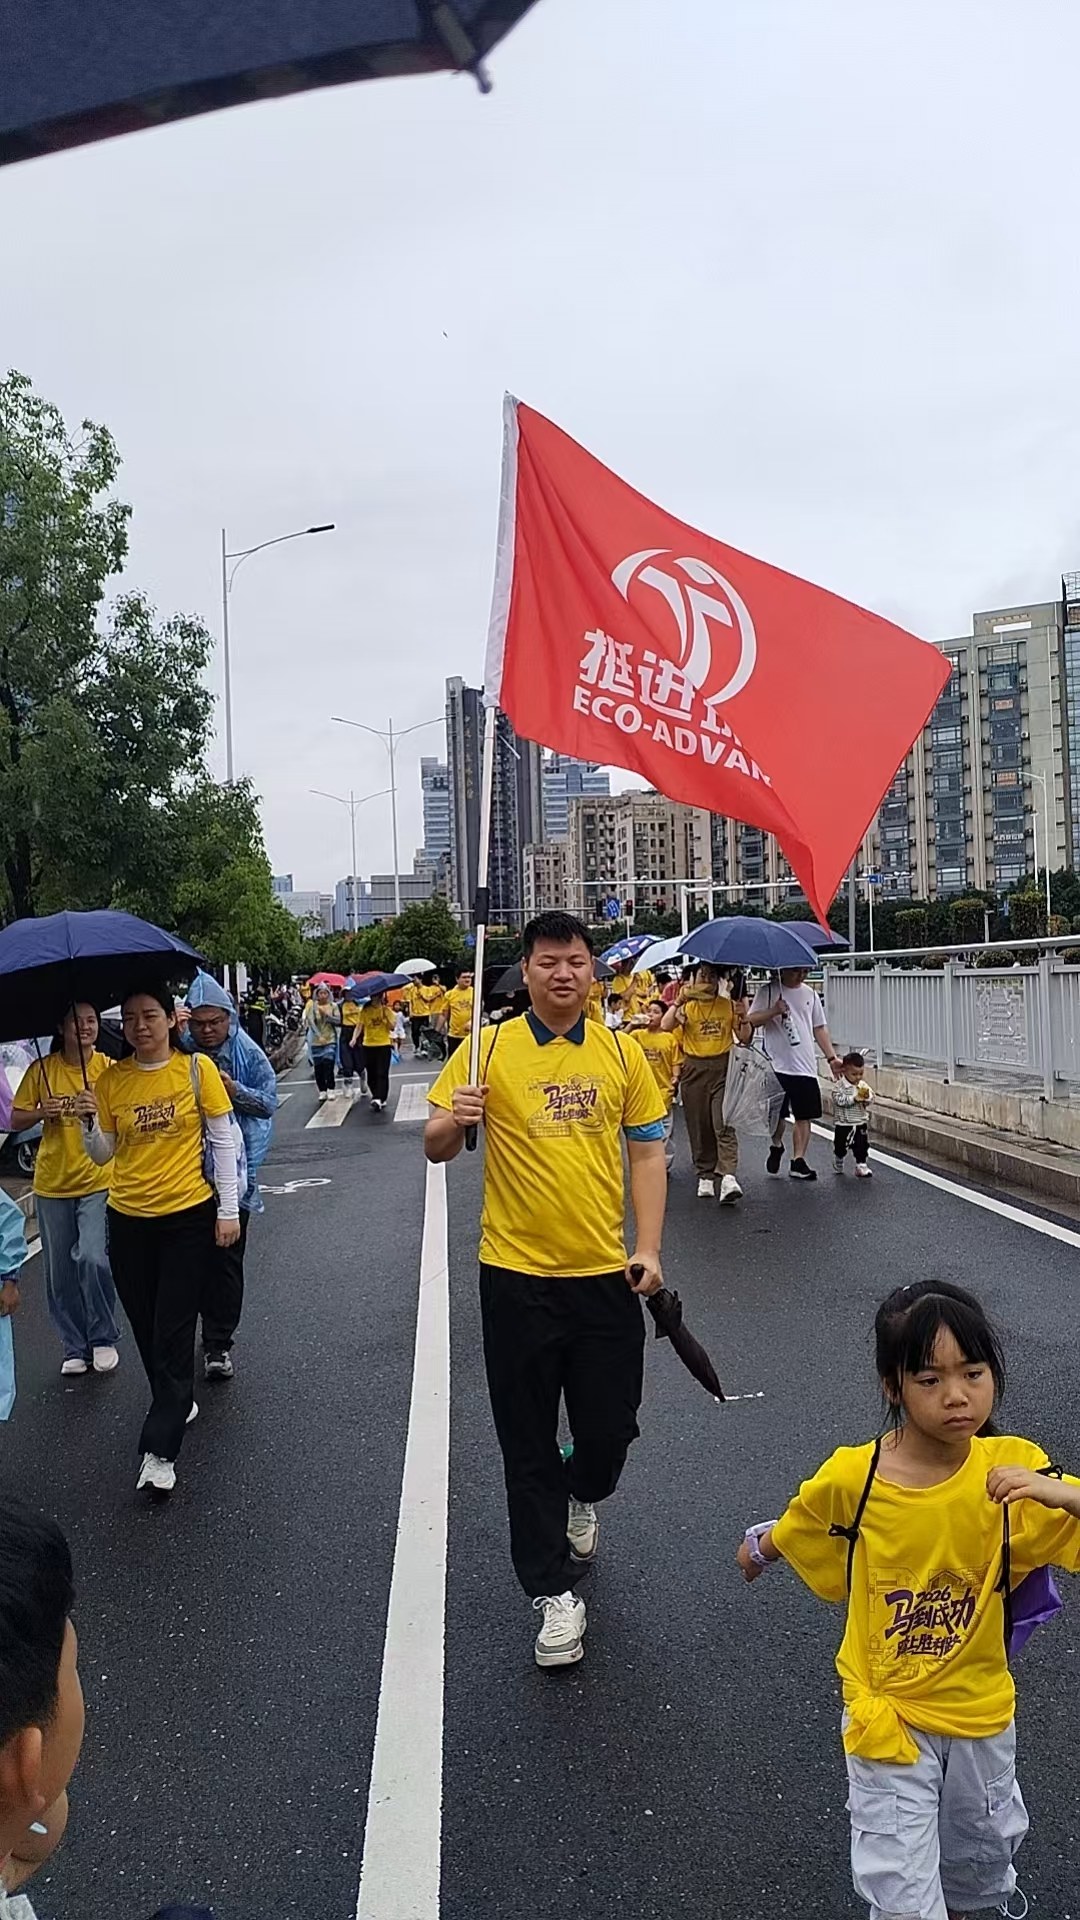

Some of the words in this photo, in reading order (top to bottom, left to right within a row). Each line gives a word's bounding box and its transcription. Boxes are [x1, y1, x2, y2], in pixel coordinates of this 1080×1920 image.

[885, 1587, 976, 1640] 马到成功
[914, 1585, 952, 1607] 2026
